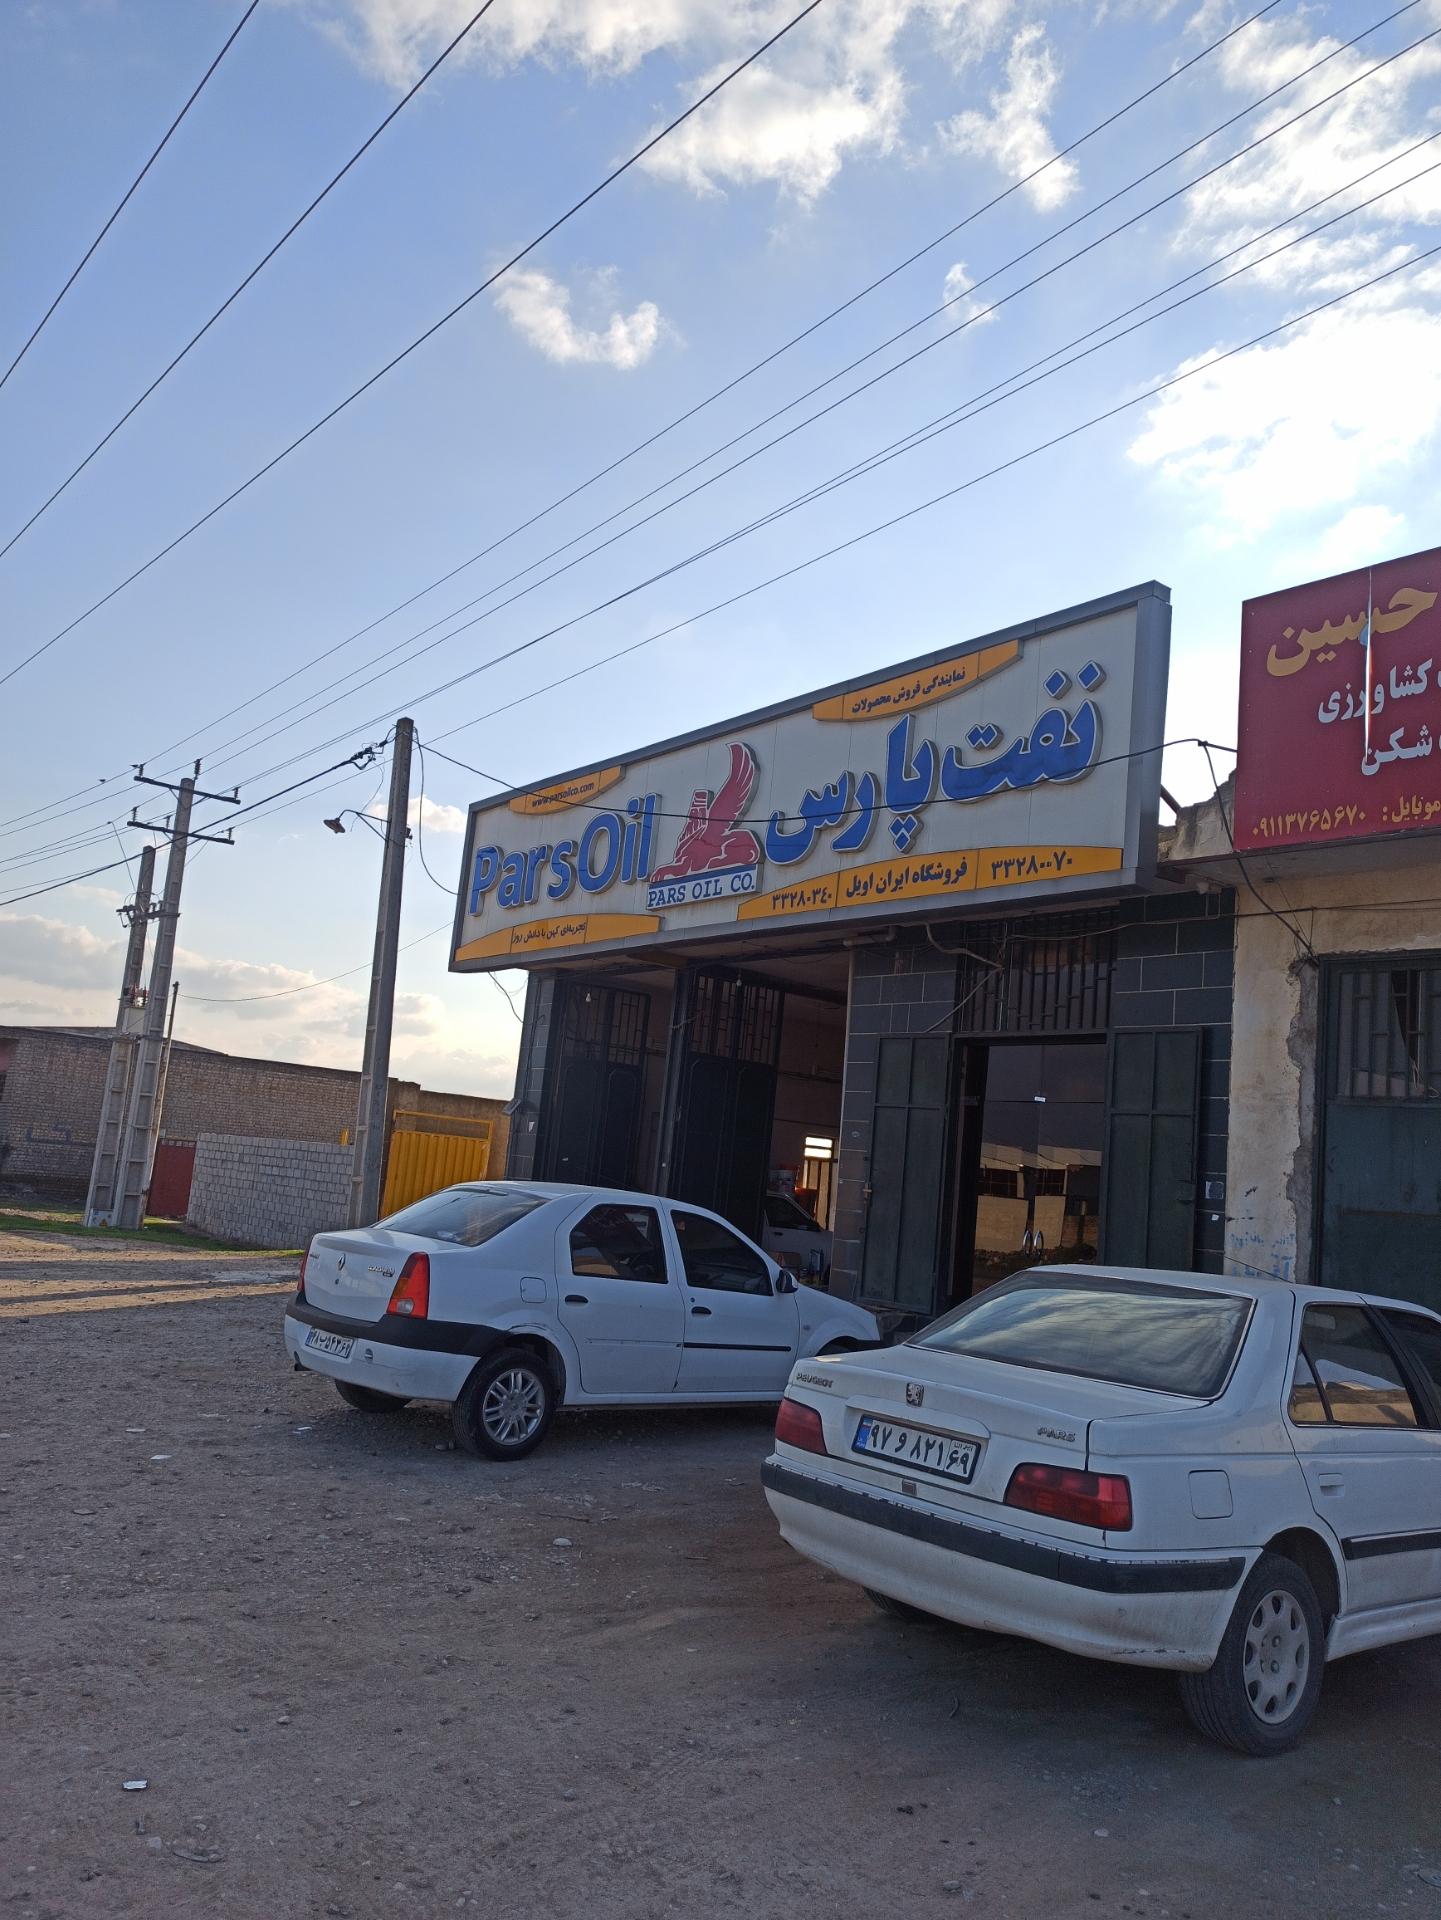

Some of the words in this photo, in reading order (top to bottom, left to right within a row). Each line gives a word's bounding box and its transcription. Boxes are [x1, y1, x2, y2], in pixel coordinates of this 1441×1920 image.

[1266, 587, 1438, 677] حسین
[893, 680, 921, 703] فروش
[922, 667, 966, 694] نمایندگی
[852, 694, 892, 713] محصولات
[940, 660, 1102, 802] نفت
[1361, 724, 1433, 776] شکن
[765, 713, 936, 865] پارس
[876, 865, 910, 894] ایران
[912, 856, 968, 885] فروشگاه
[647, 885, 686, 908] PARS
[692, 879, 723, 900] OIL
[730, 872, 755, 893] CO.
[846, 872, 874, 898] اویل
[547, 925, 560, 940] کهن
[796, 1373, 834, 1388] PEUGEOT
[1037, 1427, 1076, 1442] PARS
